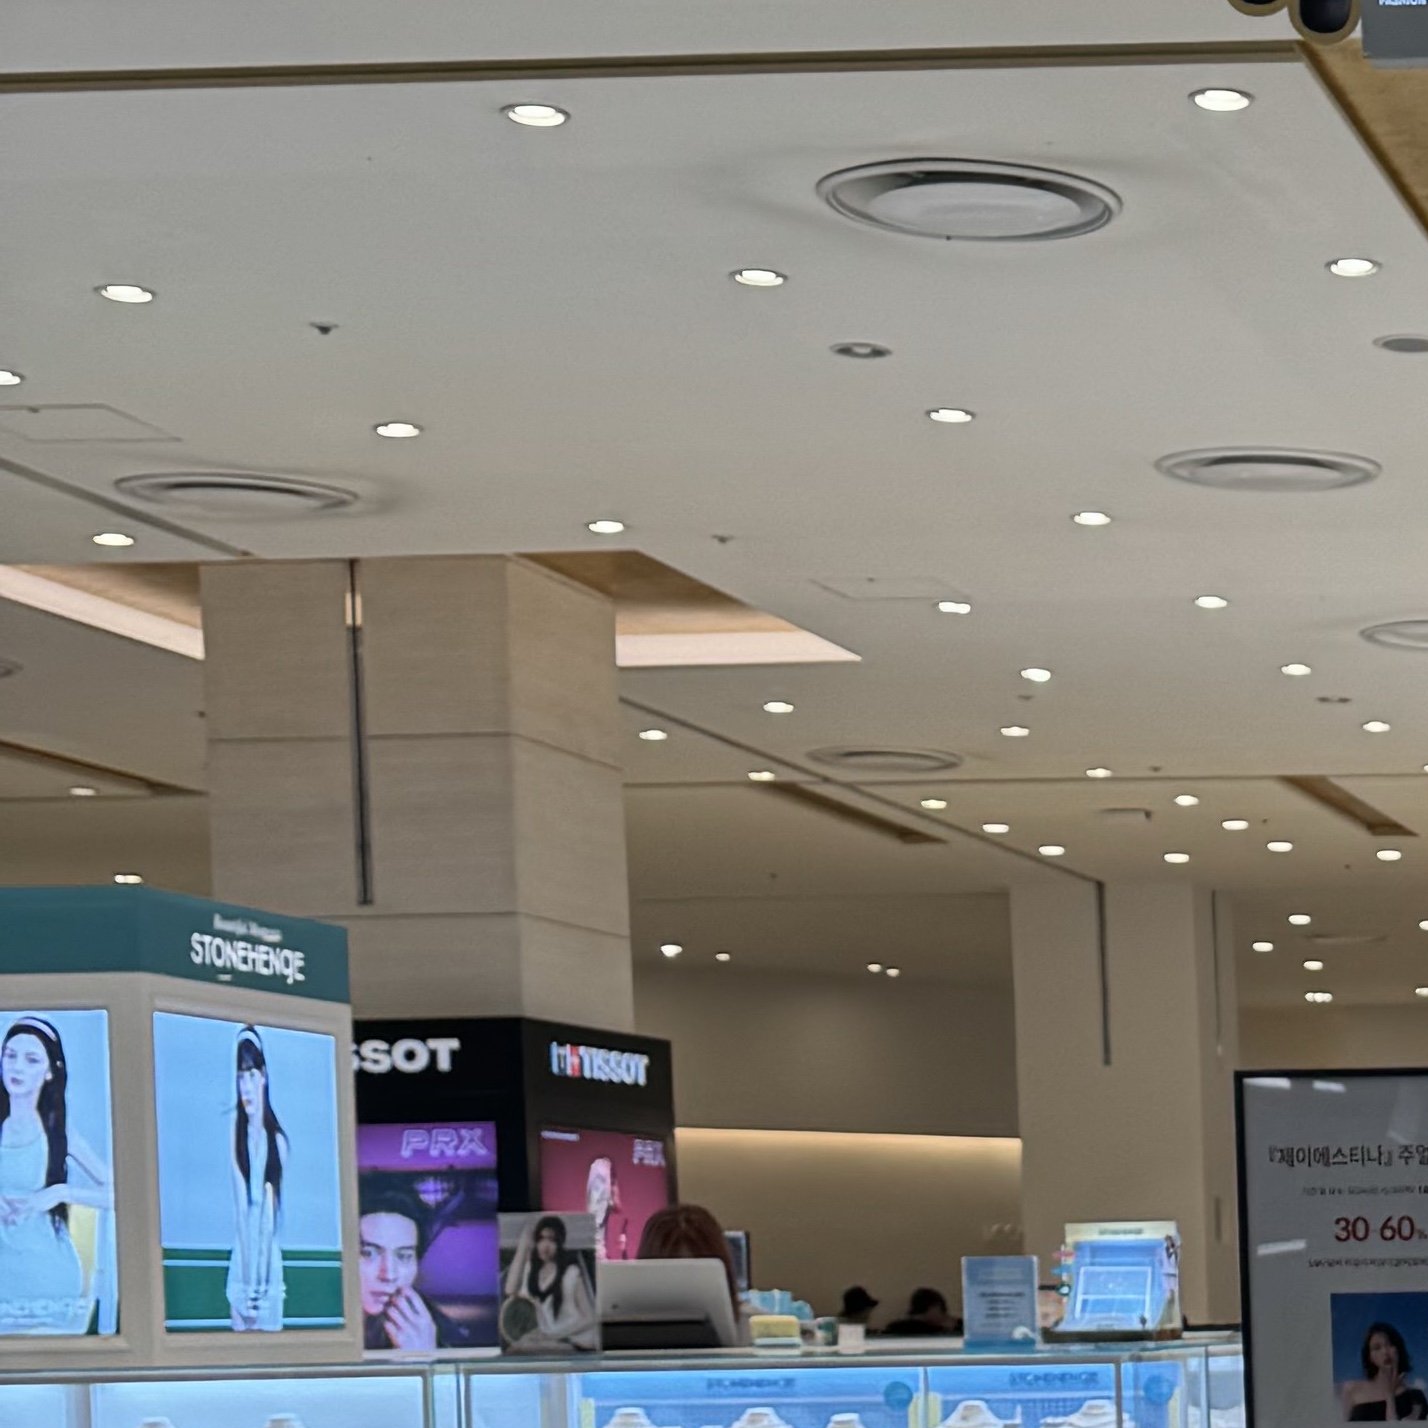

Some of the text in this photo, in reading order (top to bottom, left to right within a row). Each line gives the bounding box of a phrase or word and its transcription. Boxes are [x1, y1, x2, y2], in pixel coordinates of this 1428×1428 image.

[190, 932, 306, 985] STONEHENGE
[580, 1045, 650, 1087] TISSOT
[401, 1128, 489, 1159] PRX
